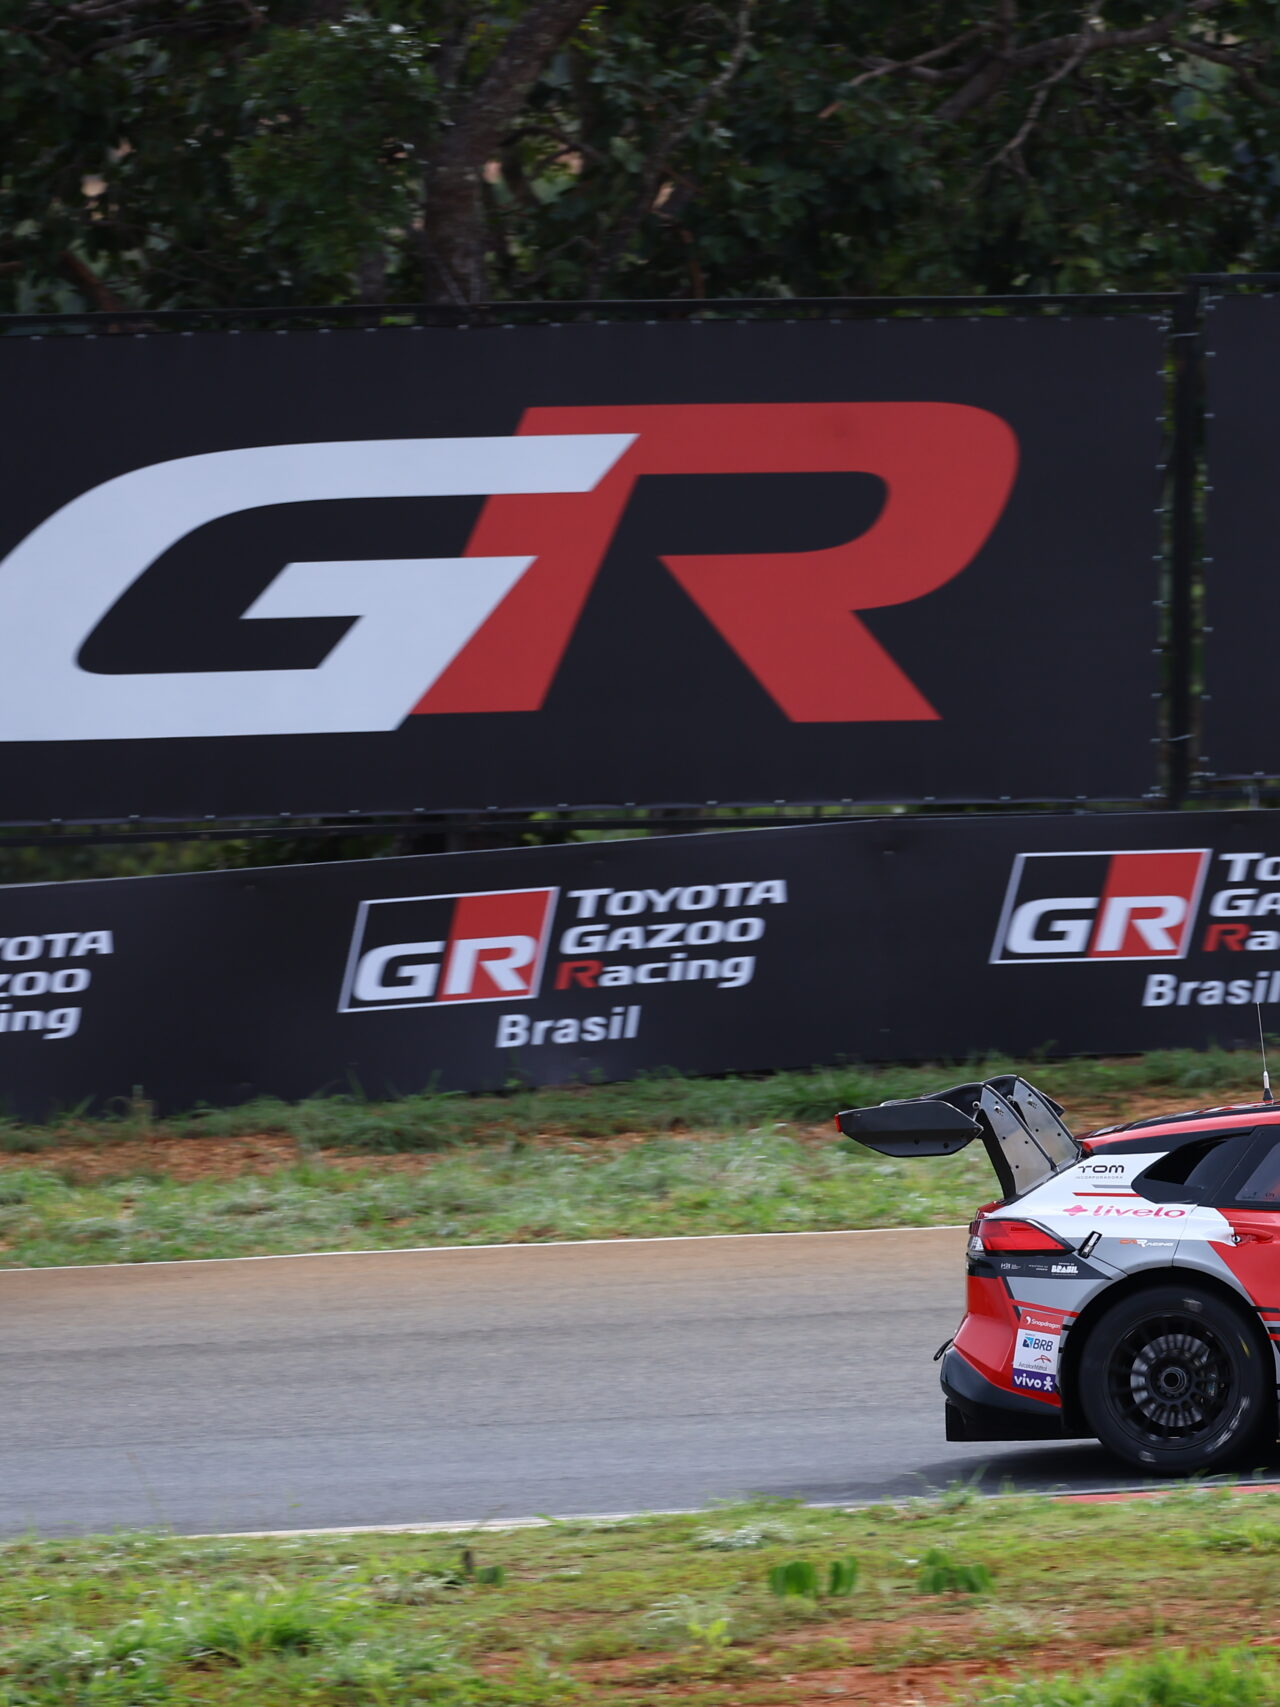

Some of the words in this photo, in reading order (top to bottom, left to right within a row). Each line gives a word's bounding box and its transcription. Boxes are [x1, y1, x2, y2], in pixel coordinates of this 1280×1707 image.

[0, 401, 1020, 742] GR
[567, 879, 788, 919] TOYOTA
[559, 914, 765, 953] GAZOO
[1004, 896, 1188, 953] GR
[352, 934, 536, 1000] GR
[554, 953, 756, 989] Racing
[496, 1004, 641, 1048] Brasil
[1078, 1164, 1125, 1173] TOM
[1093, 1205, 1186, 1218] livelo
[1031, 1319, 1061, 1329] Snapdragon
[1032, 1338, 1054, 1352] BRB
[1014, 1373, 1042, 1389] vivo
